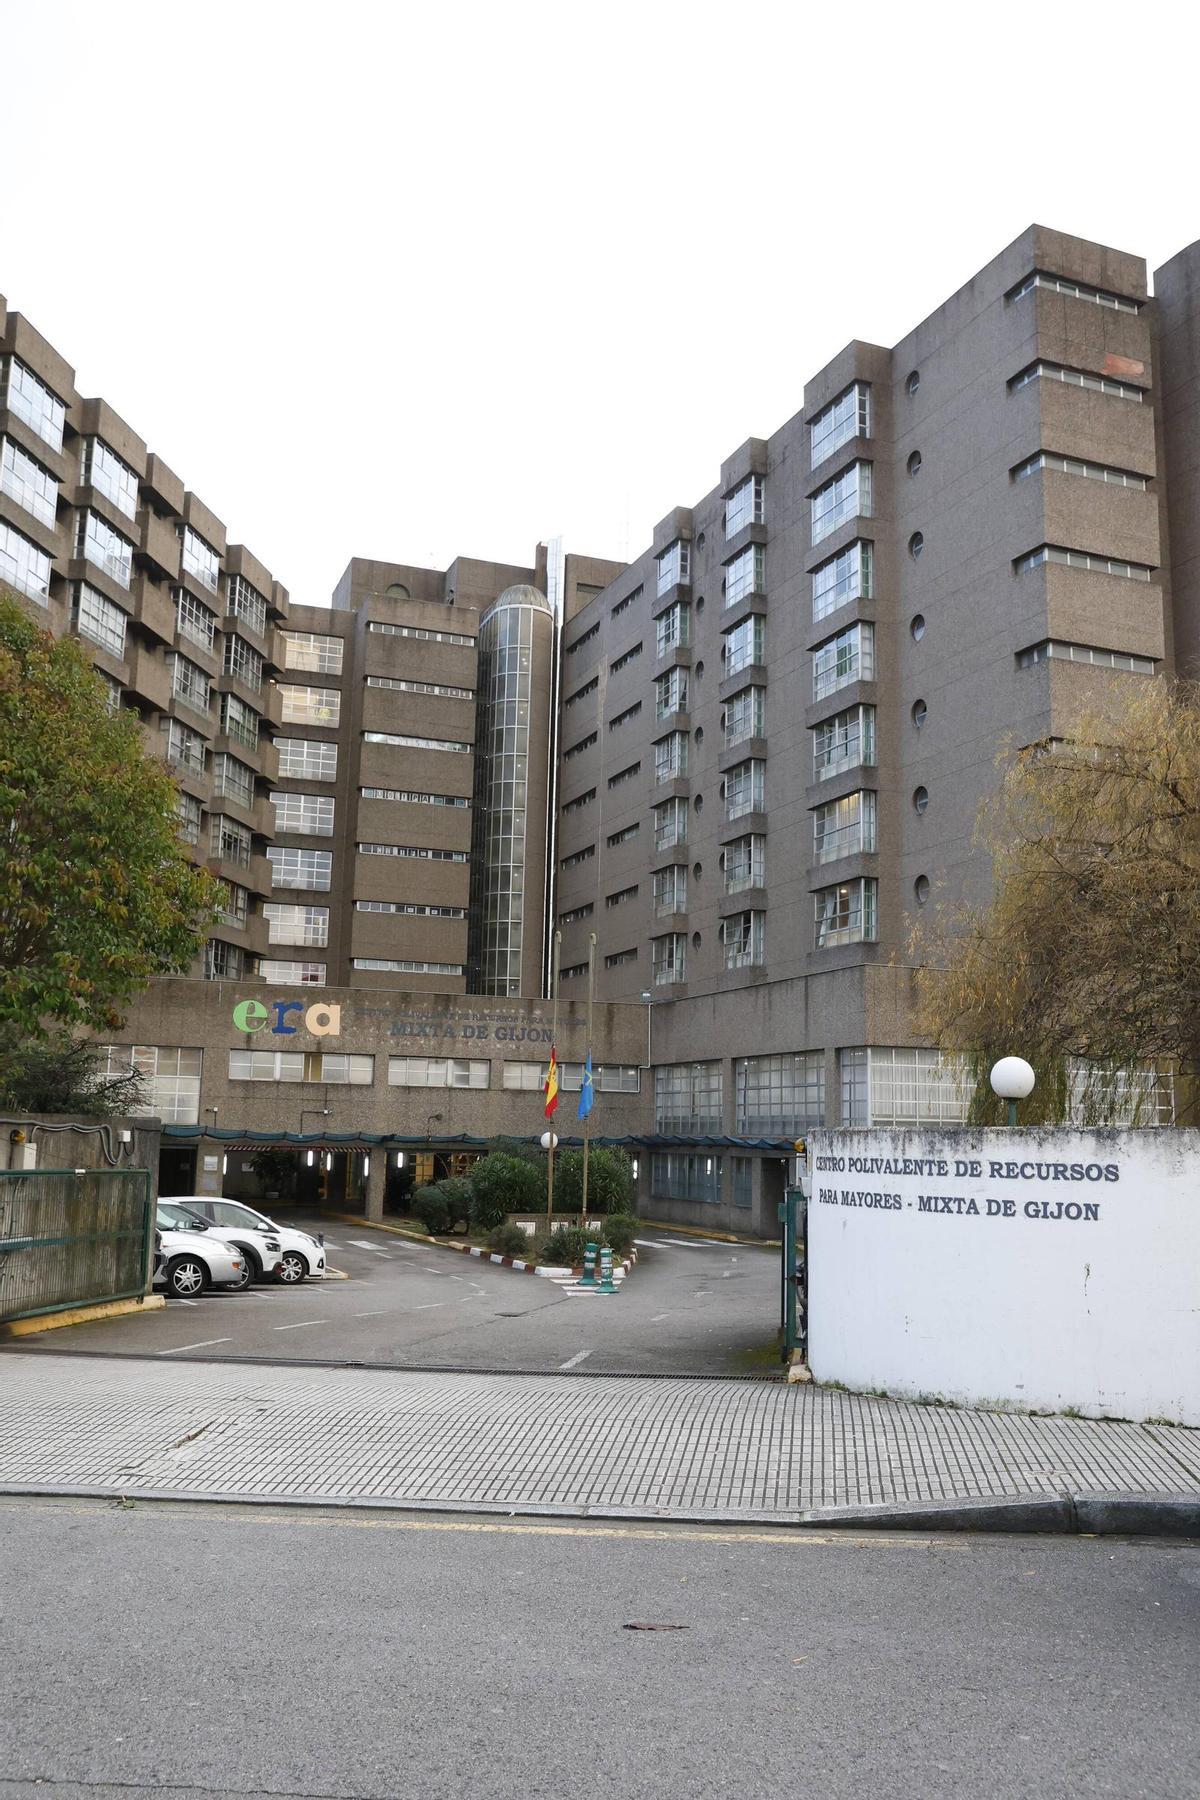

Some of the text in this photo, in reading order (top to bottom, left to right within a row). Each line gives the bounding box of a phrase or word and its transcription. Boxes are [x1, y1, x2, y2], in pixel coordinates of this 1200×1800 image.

[233, 1000, 341, 1036] era
[390, 1022, 554, 1042] MIXTA DE GIJON
[816, 1156, 1119, 1183] CENTRO POLIVALENTE DE RECURSOS
[819, 1188, 838, 1205] PARA
[841, 1190, 902, 1210] MAYORES
[918, 1196, 981, 1216] MIXTA
[986, 1199, 1017, 1218] DE
[1023, 1201, 1101, 1221] GIJON
